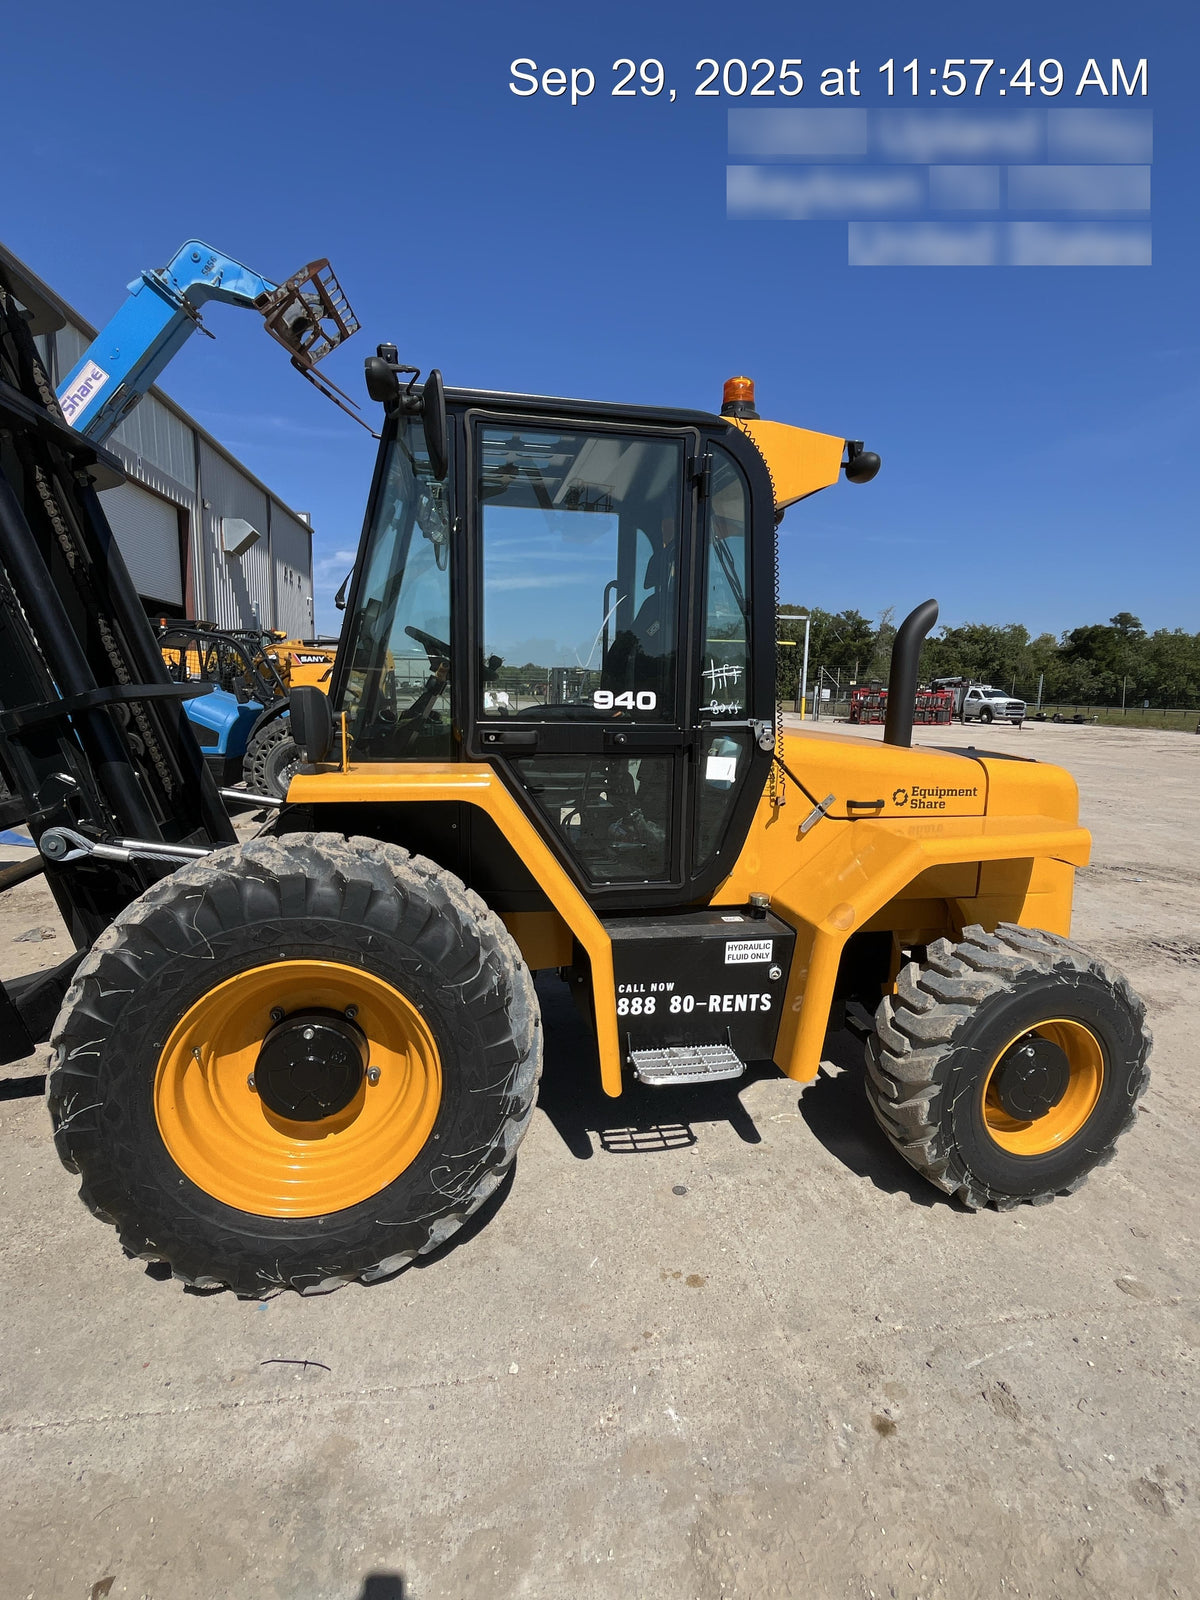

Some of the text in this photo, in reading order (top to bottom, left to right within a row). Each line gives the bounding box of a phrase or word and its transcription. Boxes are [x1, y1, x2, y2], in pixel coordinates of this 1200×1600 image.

[61, 368, 103, 417] Share
[593, 690, 657, 710] 940
[911, 786, 978, 798] Equipment
[910, 799, 946, 809] Share
[727, 943, 771, 951] HYDRAULIC
[727, 952, 770, 961] FLUID ONLY
[618, 982, 675, 993] CALL NOW
[617, 993, 772, 1016] 888 80-RENTS
